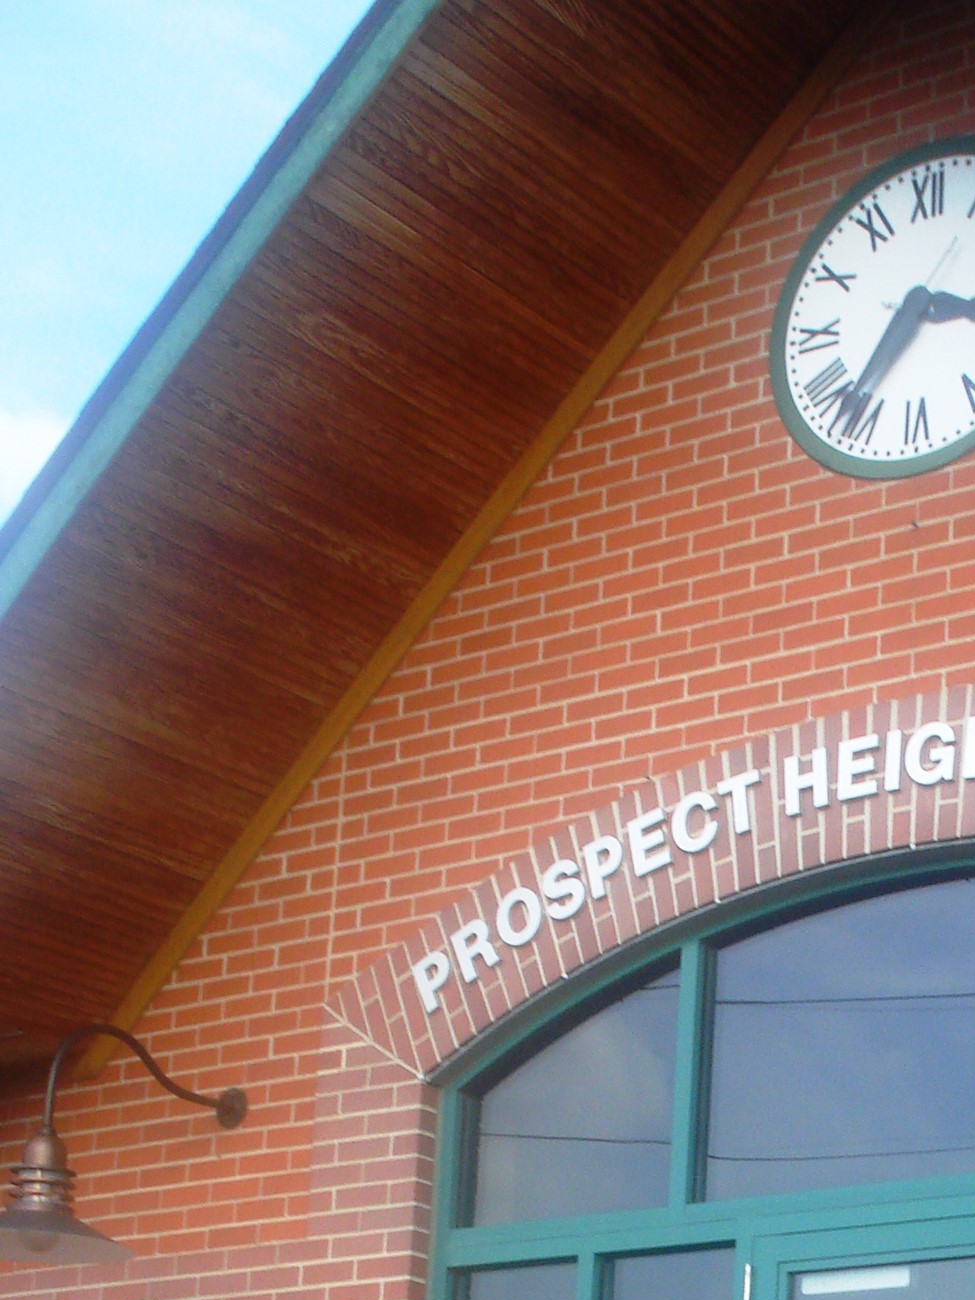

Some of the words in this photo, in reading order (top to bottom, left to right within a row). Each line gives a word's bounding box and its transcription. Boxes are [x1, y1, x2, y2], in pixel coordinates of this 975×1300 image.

[911, 171, 944, 223] XII
[855, 202, 895, 252] XI
[815, 262, 856, 292] X
[799, 318, 840, 354] IX
[904, 396, 929, 446] VI
[411, 769, 762, 1015] PROSPECT
